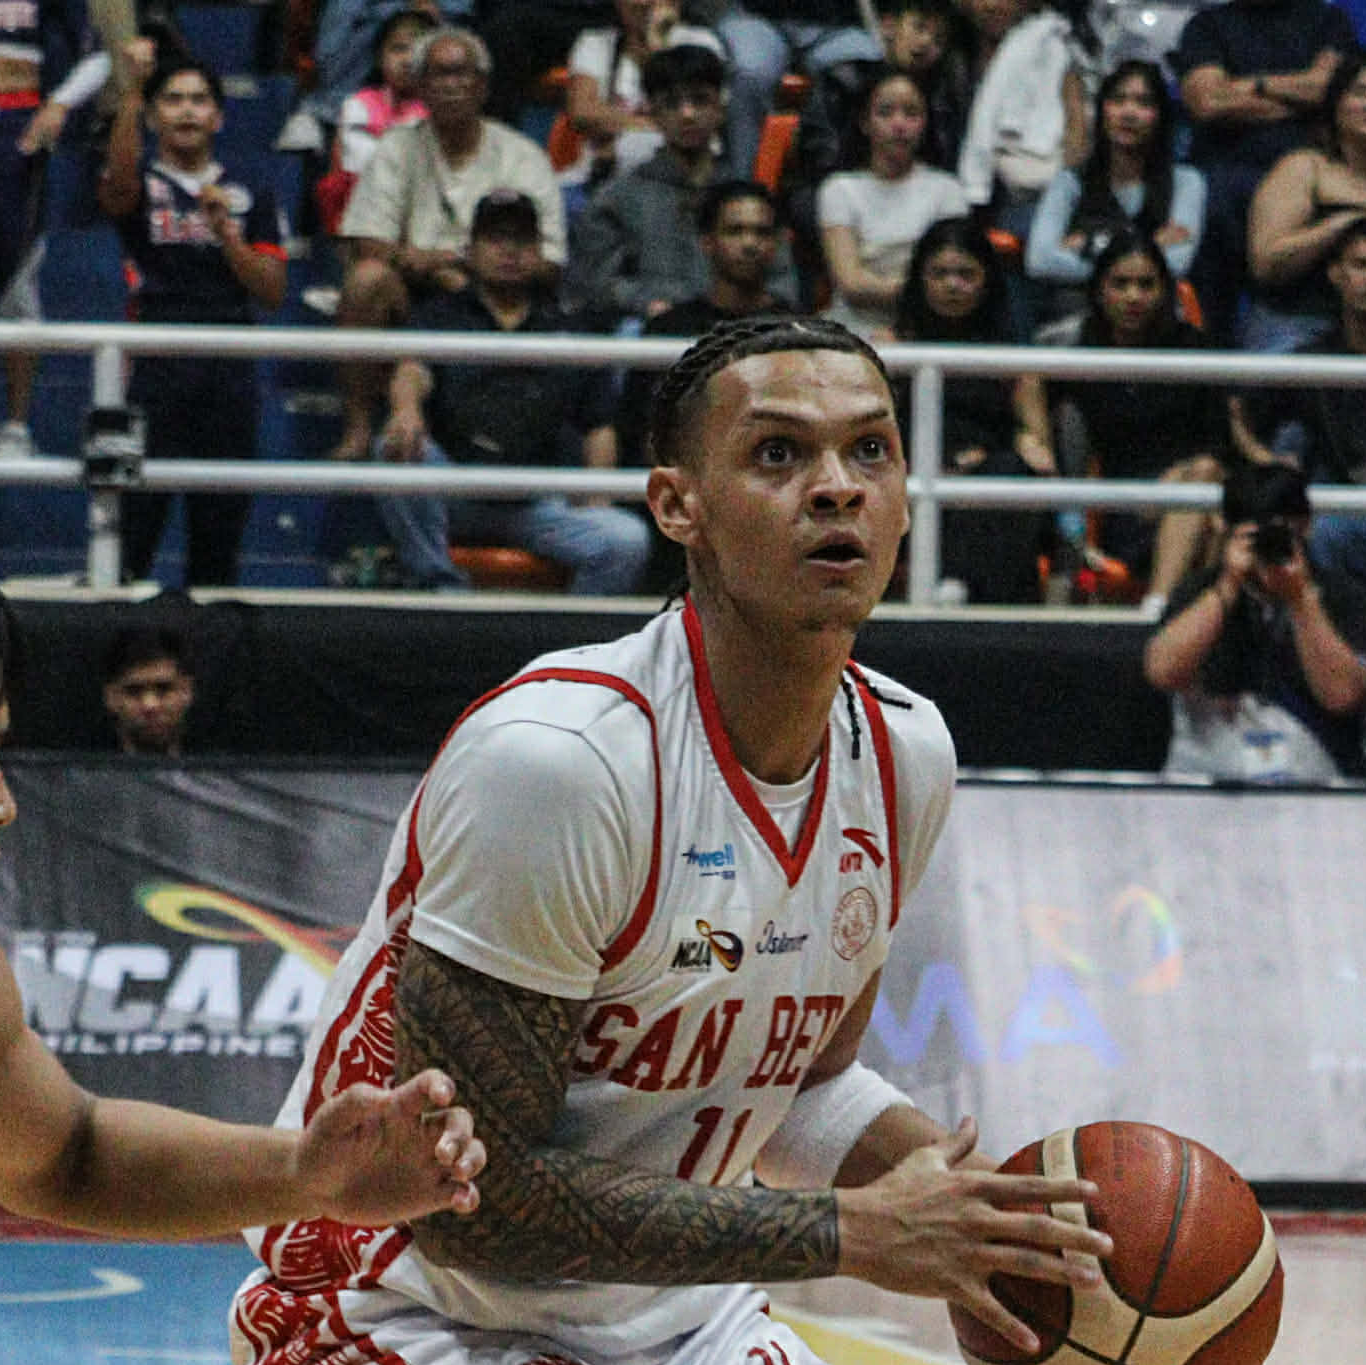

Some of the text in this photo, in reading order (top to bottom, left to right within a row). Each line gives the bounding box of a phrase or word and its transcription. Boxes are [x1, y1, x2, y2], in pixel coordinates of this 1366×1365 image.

[14, 940, 331, 1034] NCAA
[872, 961, 1124, 1068] MA
[571, 999, 744, 1092] SAN
[676, 1105, 754, 1186] 11
